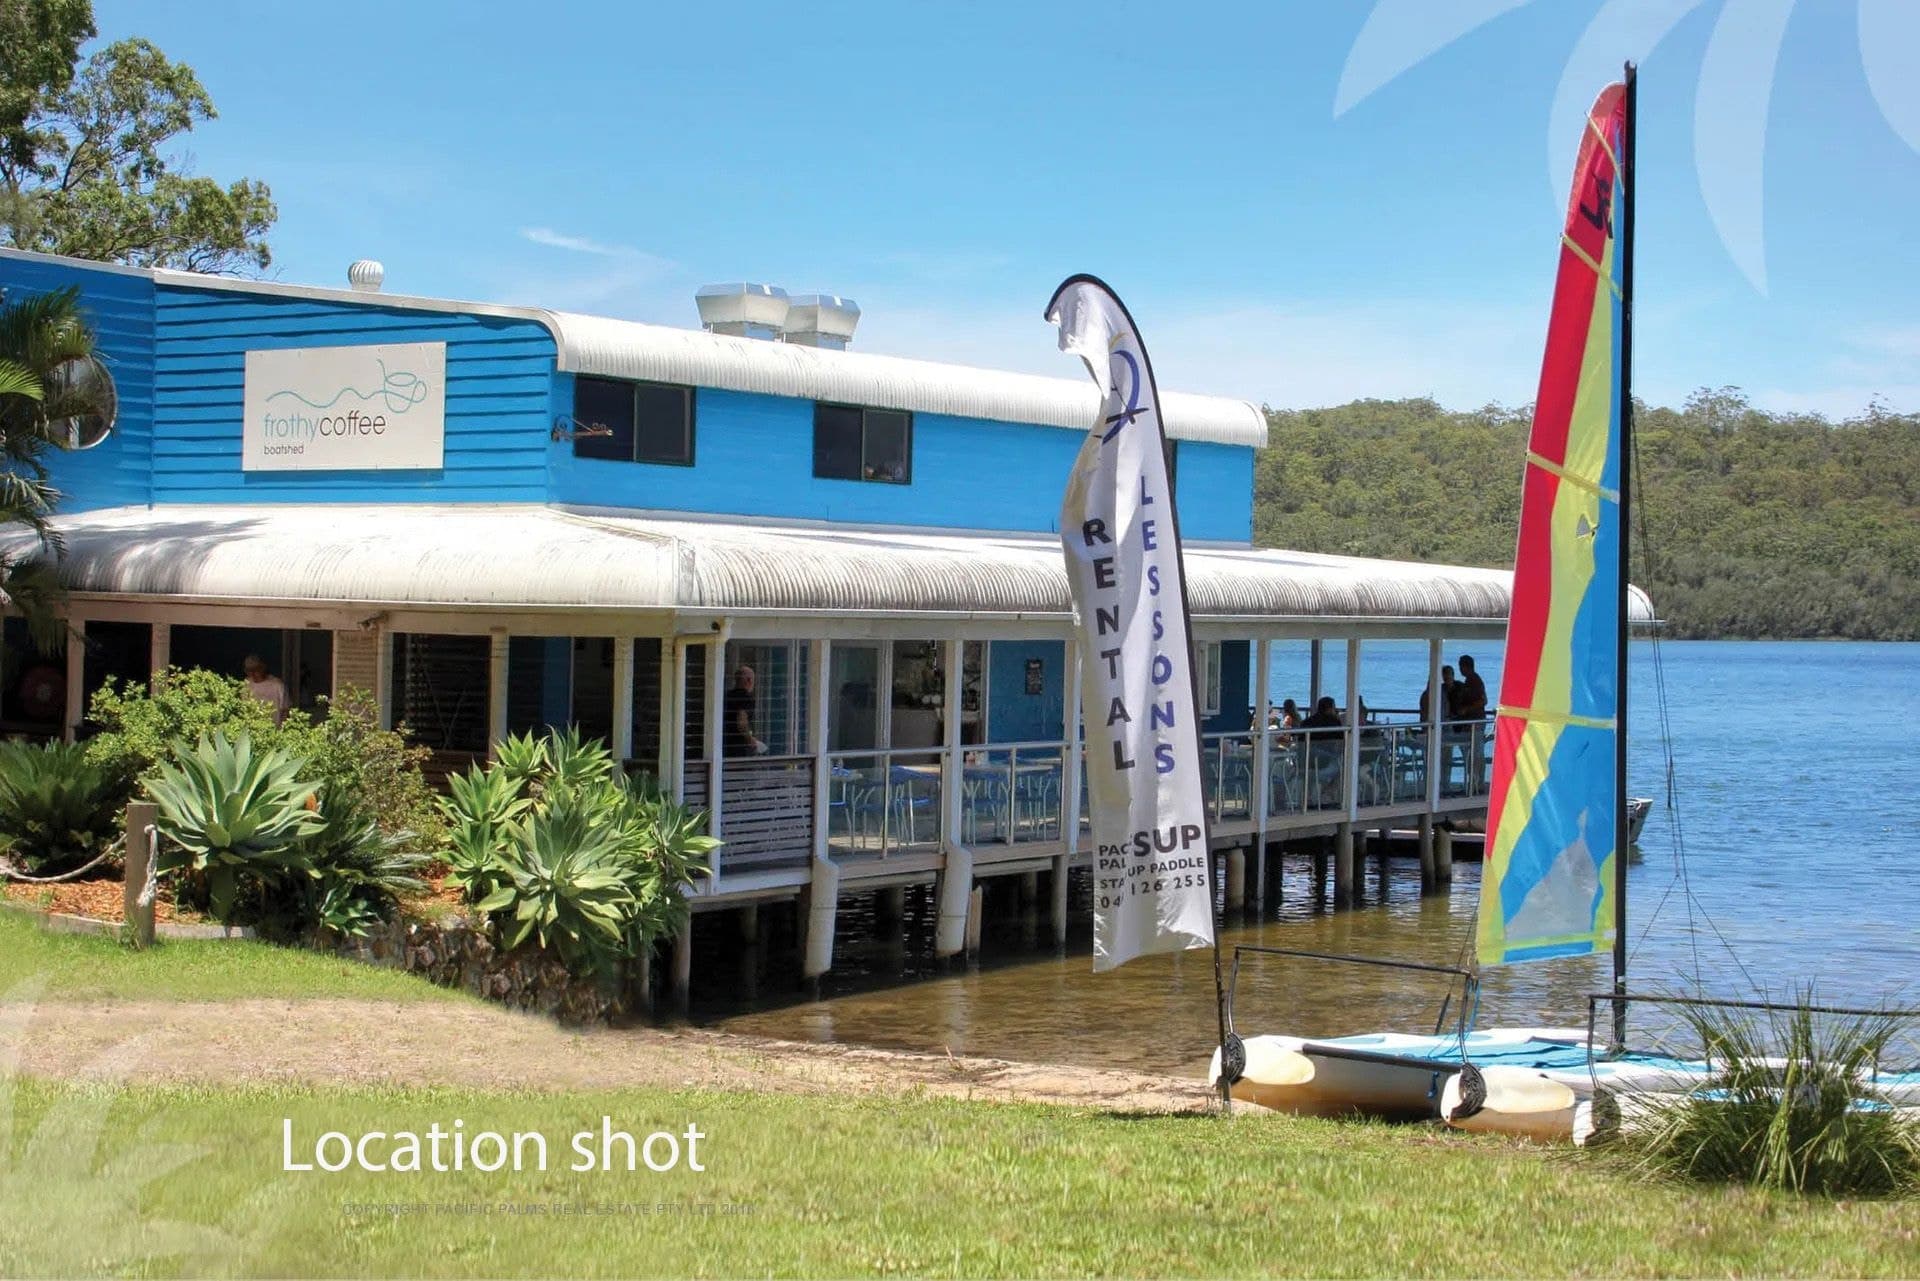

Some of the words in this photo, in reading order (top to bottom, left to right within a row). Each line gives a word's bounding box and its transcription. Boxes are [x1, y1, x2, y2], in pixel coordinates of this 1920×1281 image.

[263, 444, 304, 455] boatshed
[1141, 476, 1175, 774] LESSONS
[1082, 518, 1135, 771] RENTAL
[1133, 824, 1201, 857] SUP
[1150, 857, 1205, 873] PADDLE
